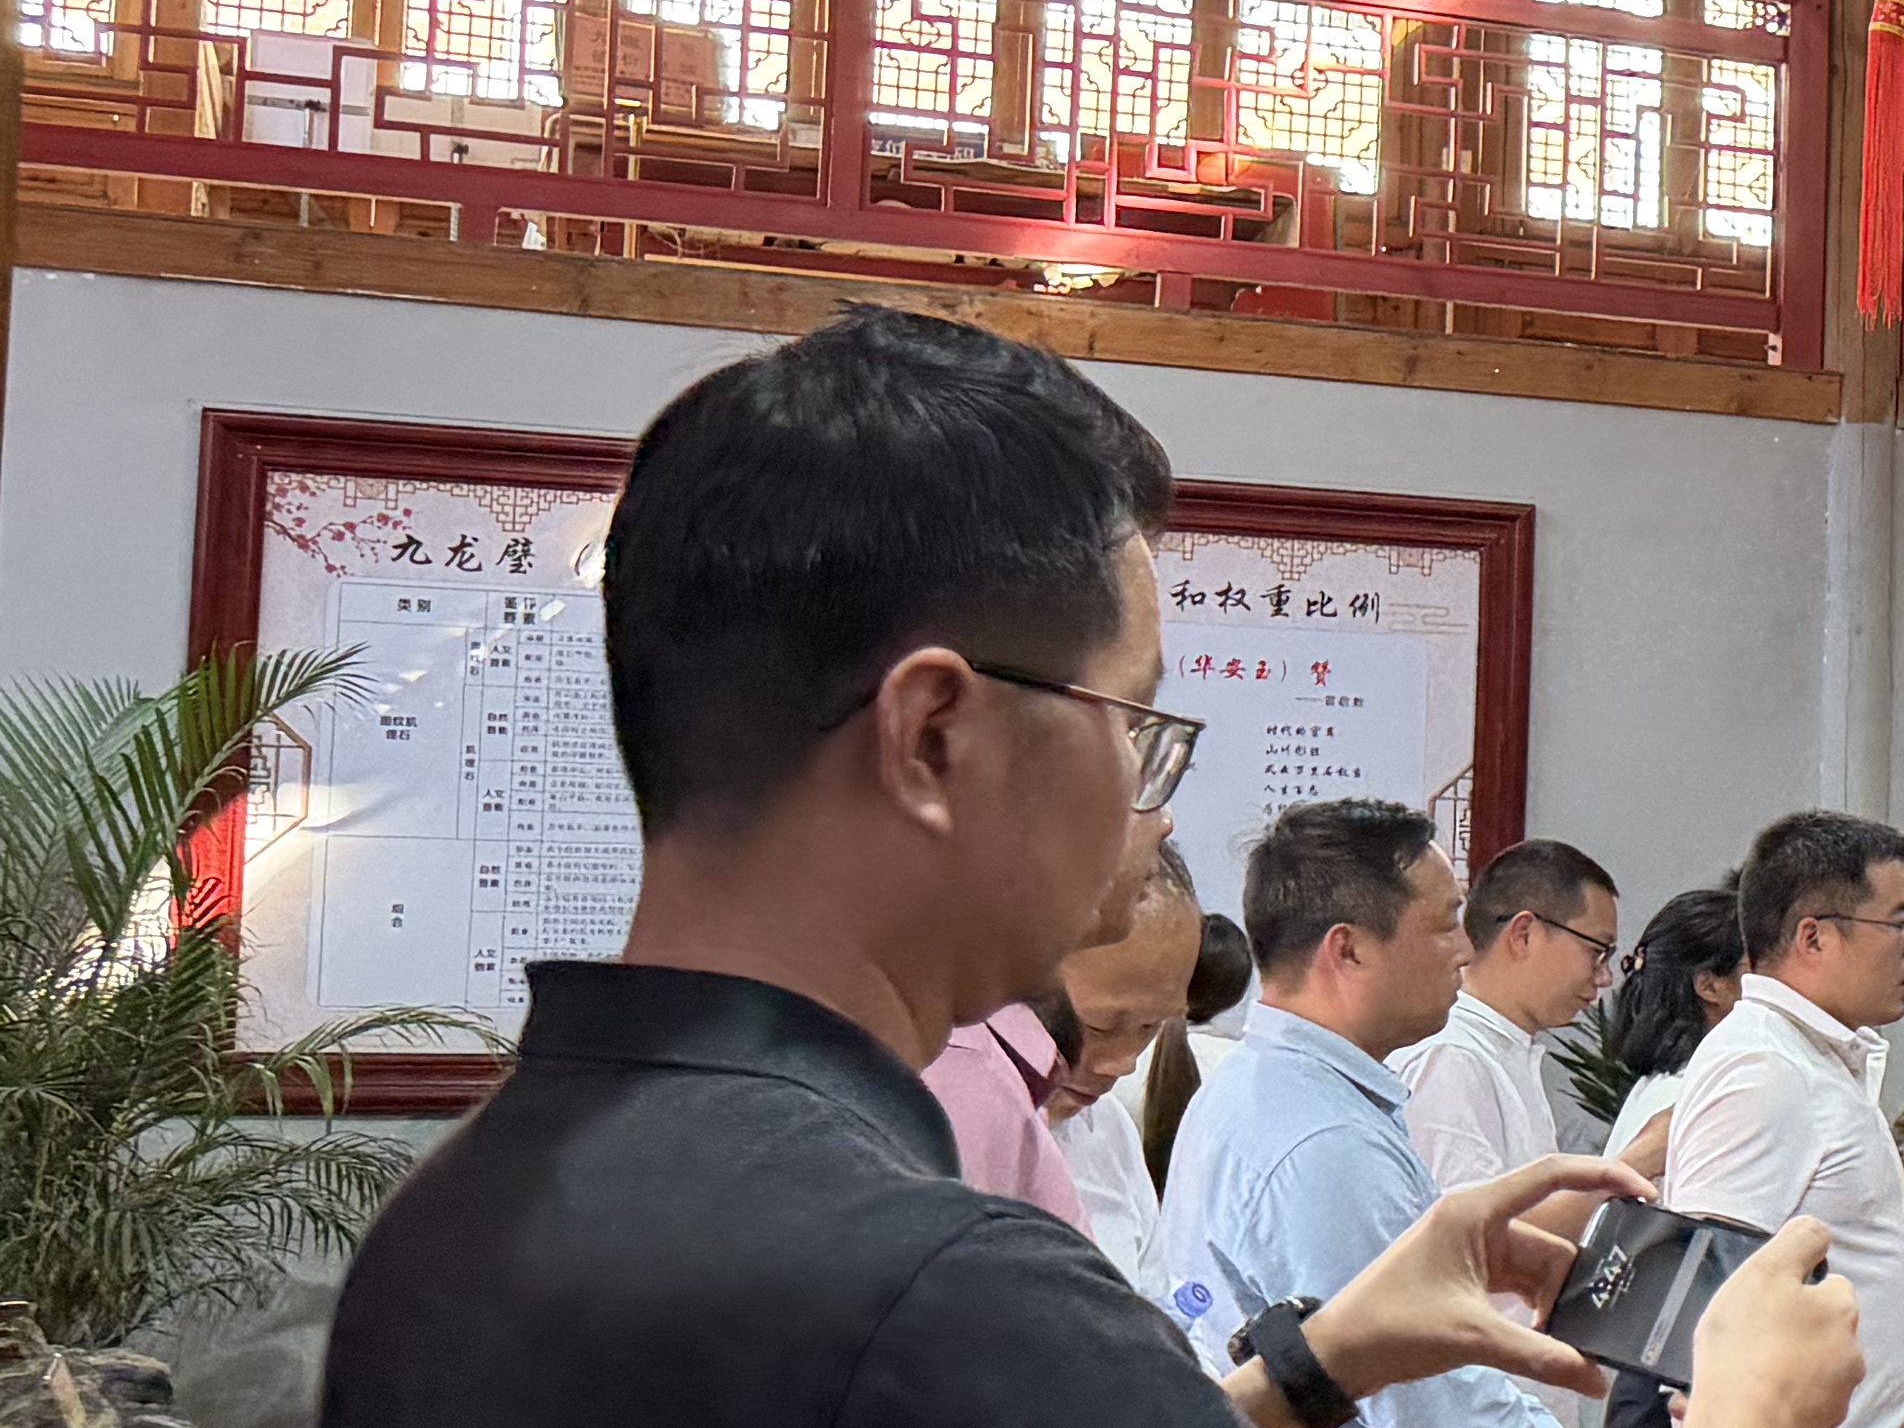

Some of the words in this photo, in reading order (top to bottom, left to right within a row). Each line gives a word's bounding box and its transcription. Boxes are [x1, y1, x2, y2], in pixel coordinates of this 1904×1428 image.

[397, 598, 432, 613] 类别
[1169, 579, 1381, 623] 和权重比例
